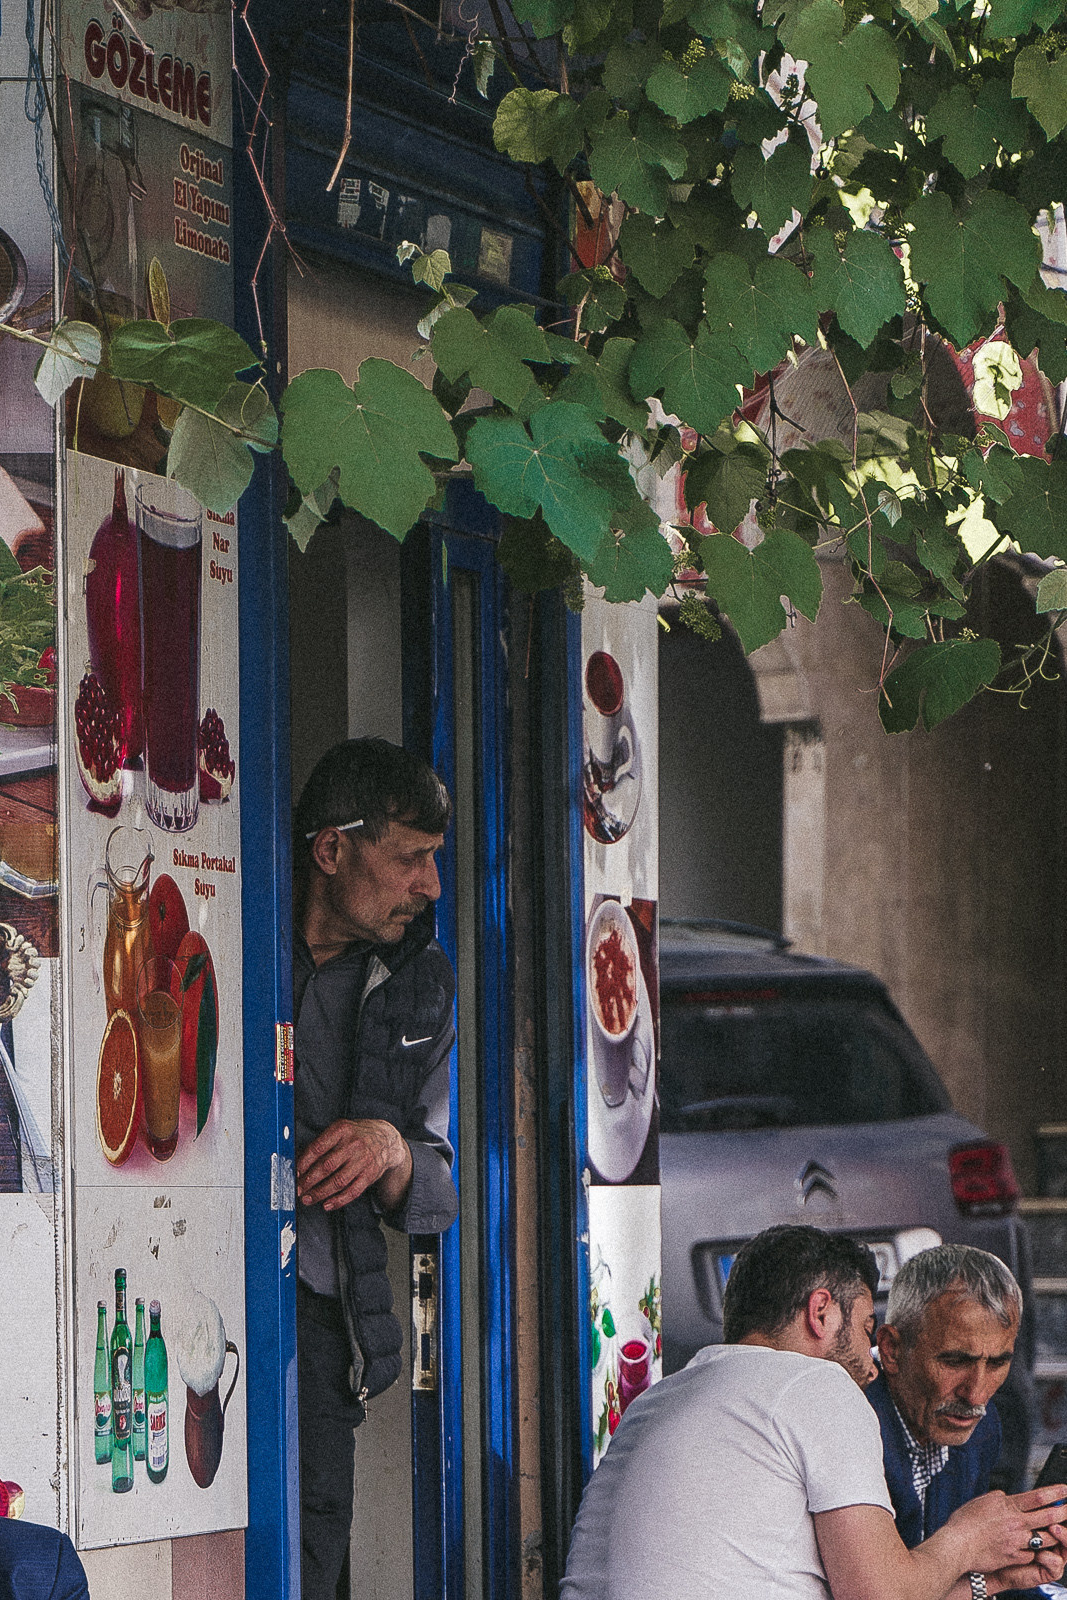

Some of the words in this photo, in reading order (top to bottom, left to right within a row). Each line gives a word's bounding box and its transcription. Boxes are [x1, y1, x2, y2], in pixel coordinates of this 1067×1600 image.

[84, 12, 212, 127] GÖZLEME
[179, 143, 224, 186] Orjinal
[174, 178, 188, 210] El
[174, 217, 230, 265] Limonata
[212, 531, 230, 554] Nar
[209, 559, 234, 585] Suyu
[173, 848, 199, 869] Sıkma
[200, 851, 236, 873] Portakal
[194, 877, 216, 900] Suyu
